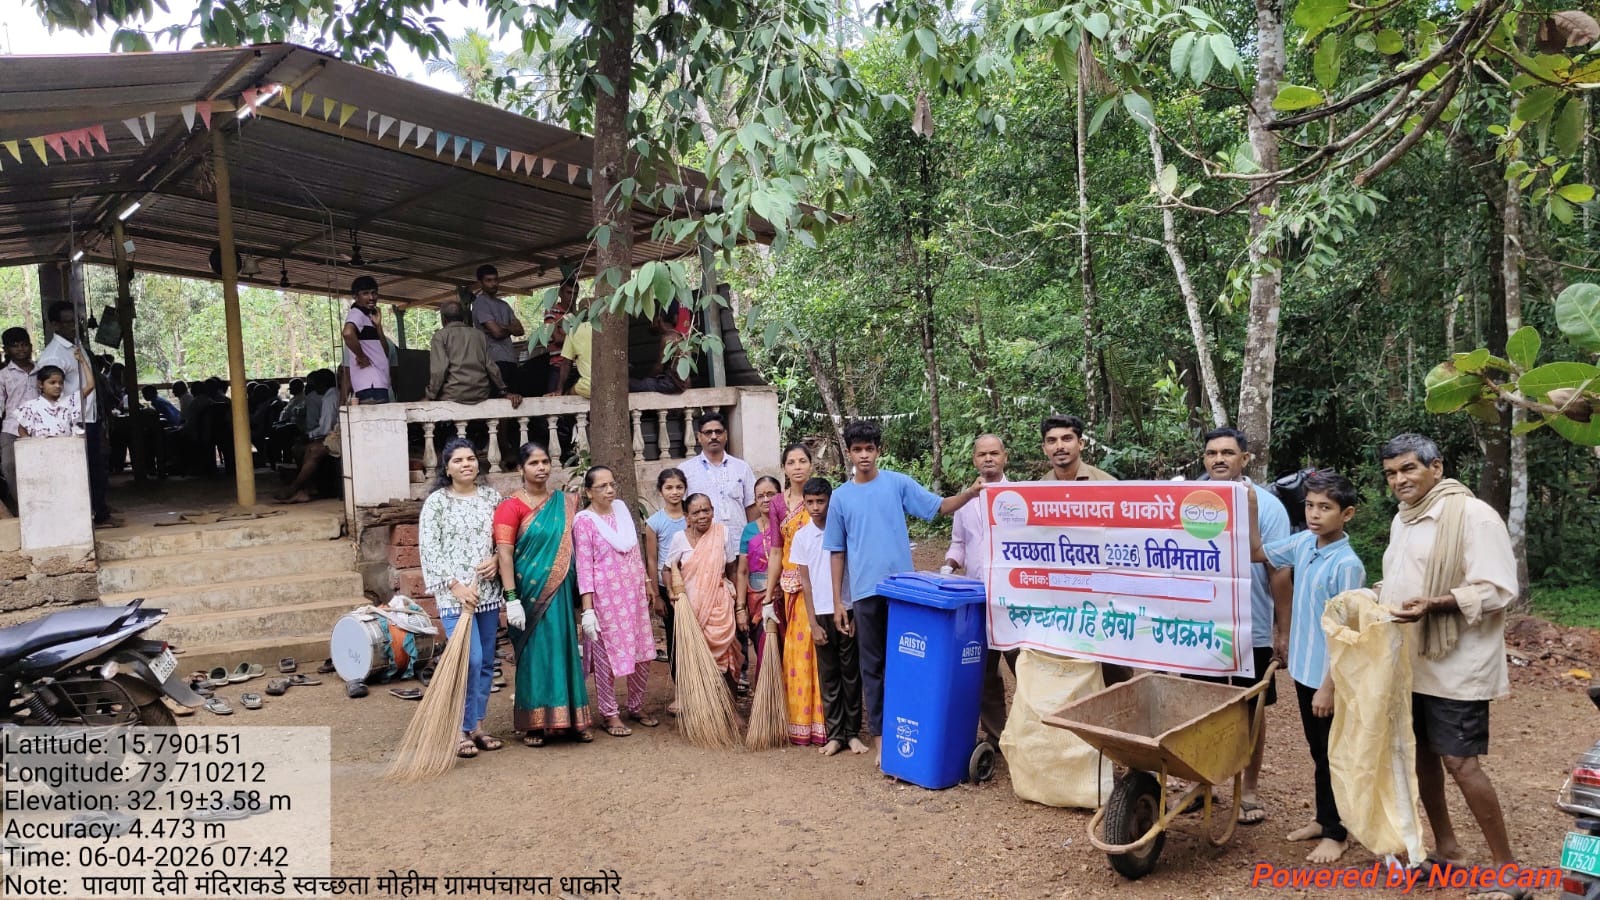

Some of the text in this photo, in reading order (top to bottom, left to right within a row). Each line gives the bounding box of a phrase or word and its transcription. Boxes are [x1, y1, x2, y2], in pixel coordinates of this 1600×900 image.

[1032, 494, 1114, 520] ग्रामपंचायत
[1120, 494, 1175, 520] धाकोरे
[1002, 534, 1221, 572] स्वच्छता दिवस 2026 निमित्ताने
[1020, 571, 1048, 586] दिनांक:
[1078, 600, 1098, 637] हि
[1151, 614, 1221, 650] उपक्रम.
[899, 635, 926, 651] ARISTO
[962, 646, 981, 658] ARISTO
[1567, 851, 1595, 871] T7520
